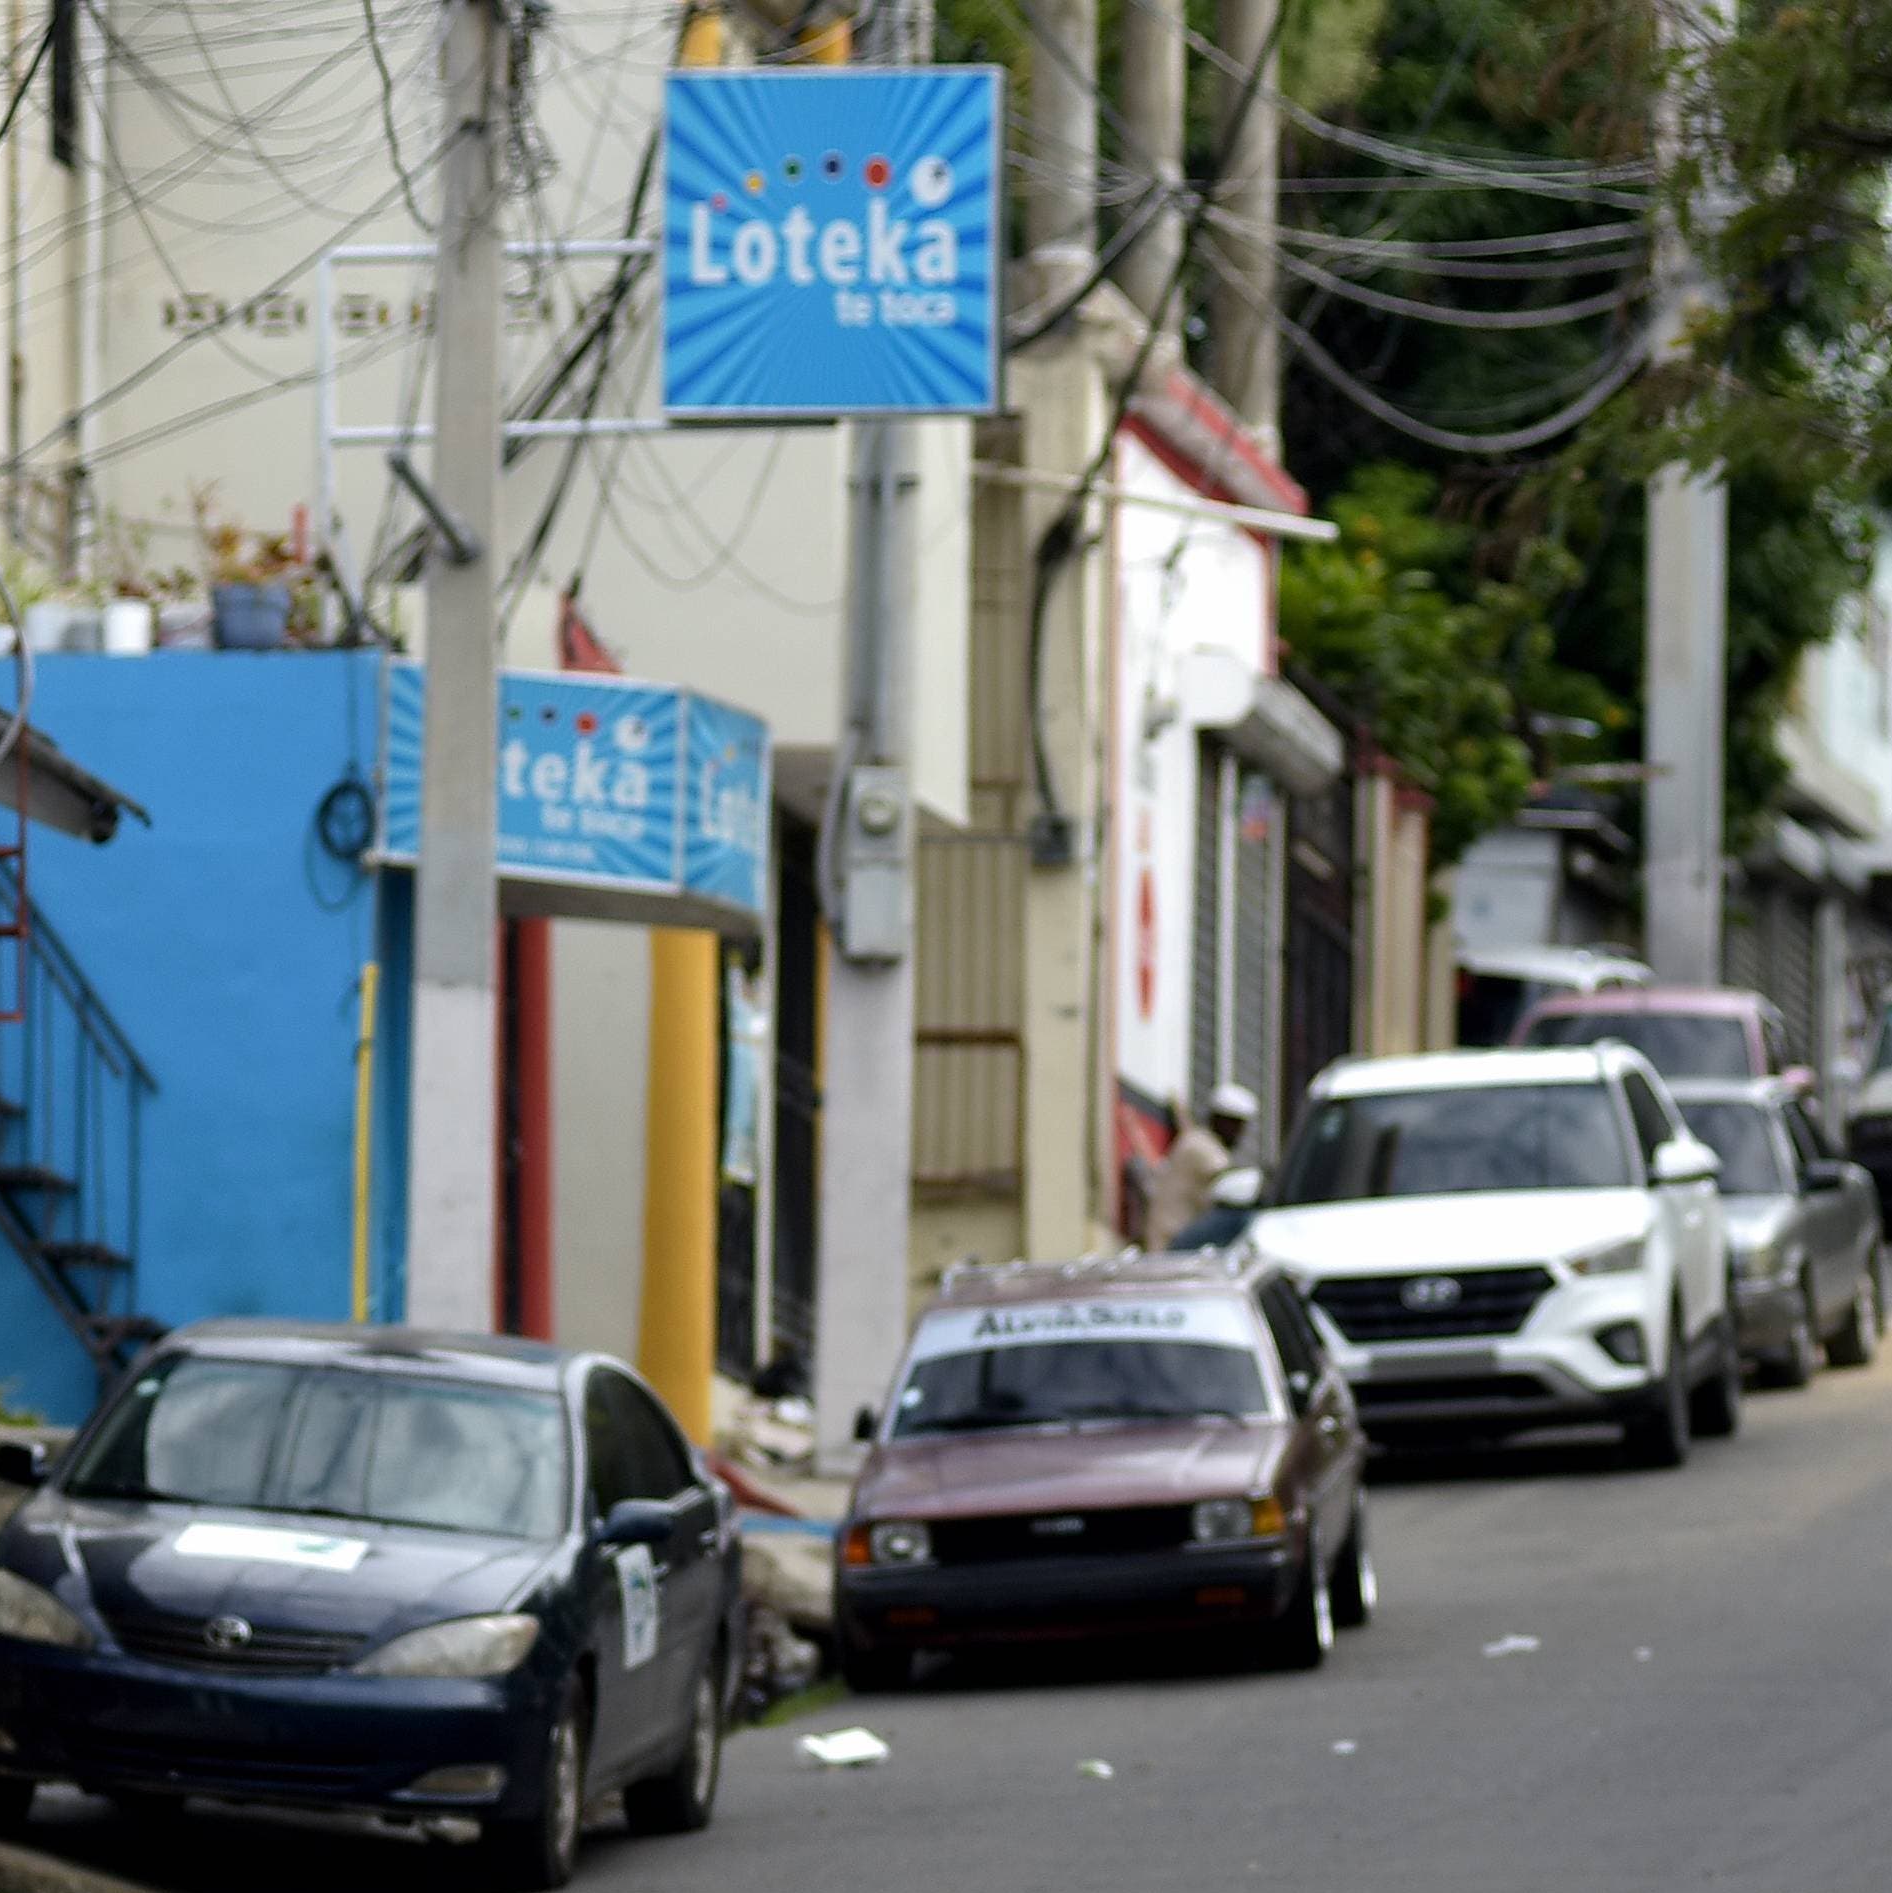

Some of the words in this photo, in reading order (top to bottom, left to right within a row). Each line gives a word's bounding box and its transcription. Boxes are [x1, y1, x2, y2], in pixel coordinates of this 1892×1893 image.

[691, 196, 957, 286] Loteka
[835, 287, 874, 326] te
[878, 287, 957, 326] toca
[503, 737, 649, 808] teka
